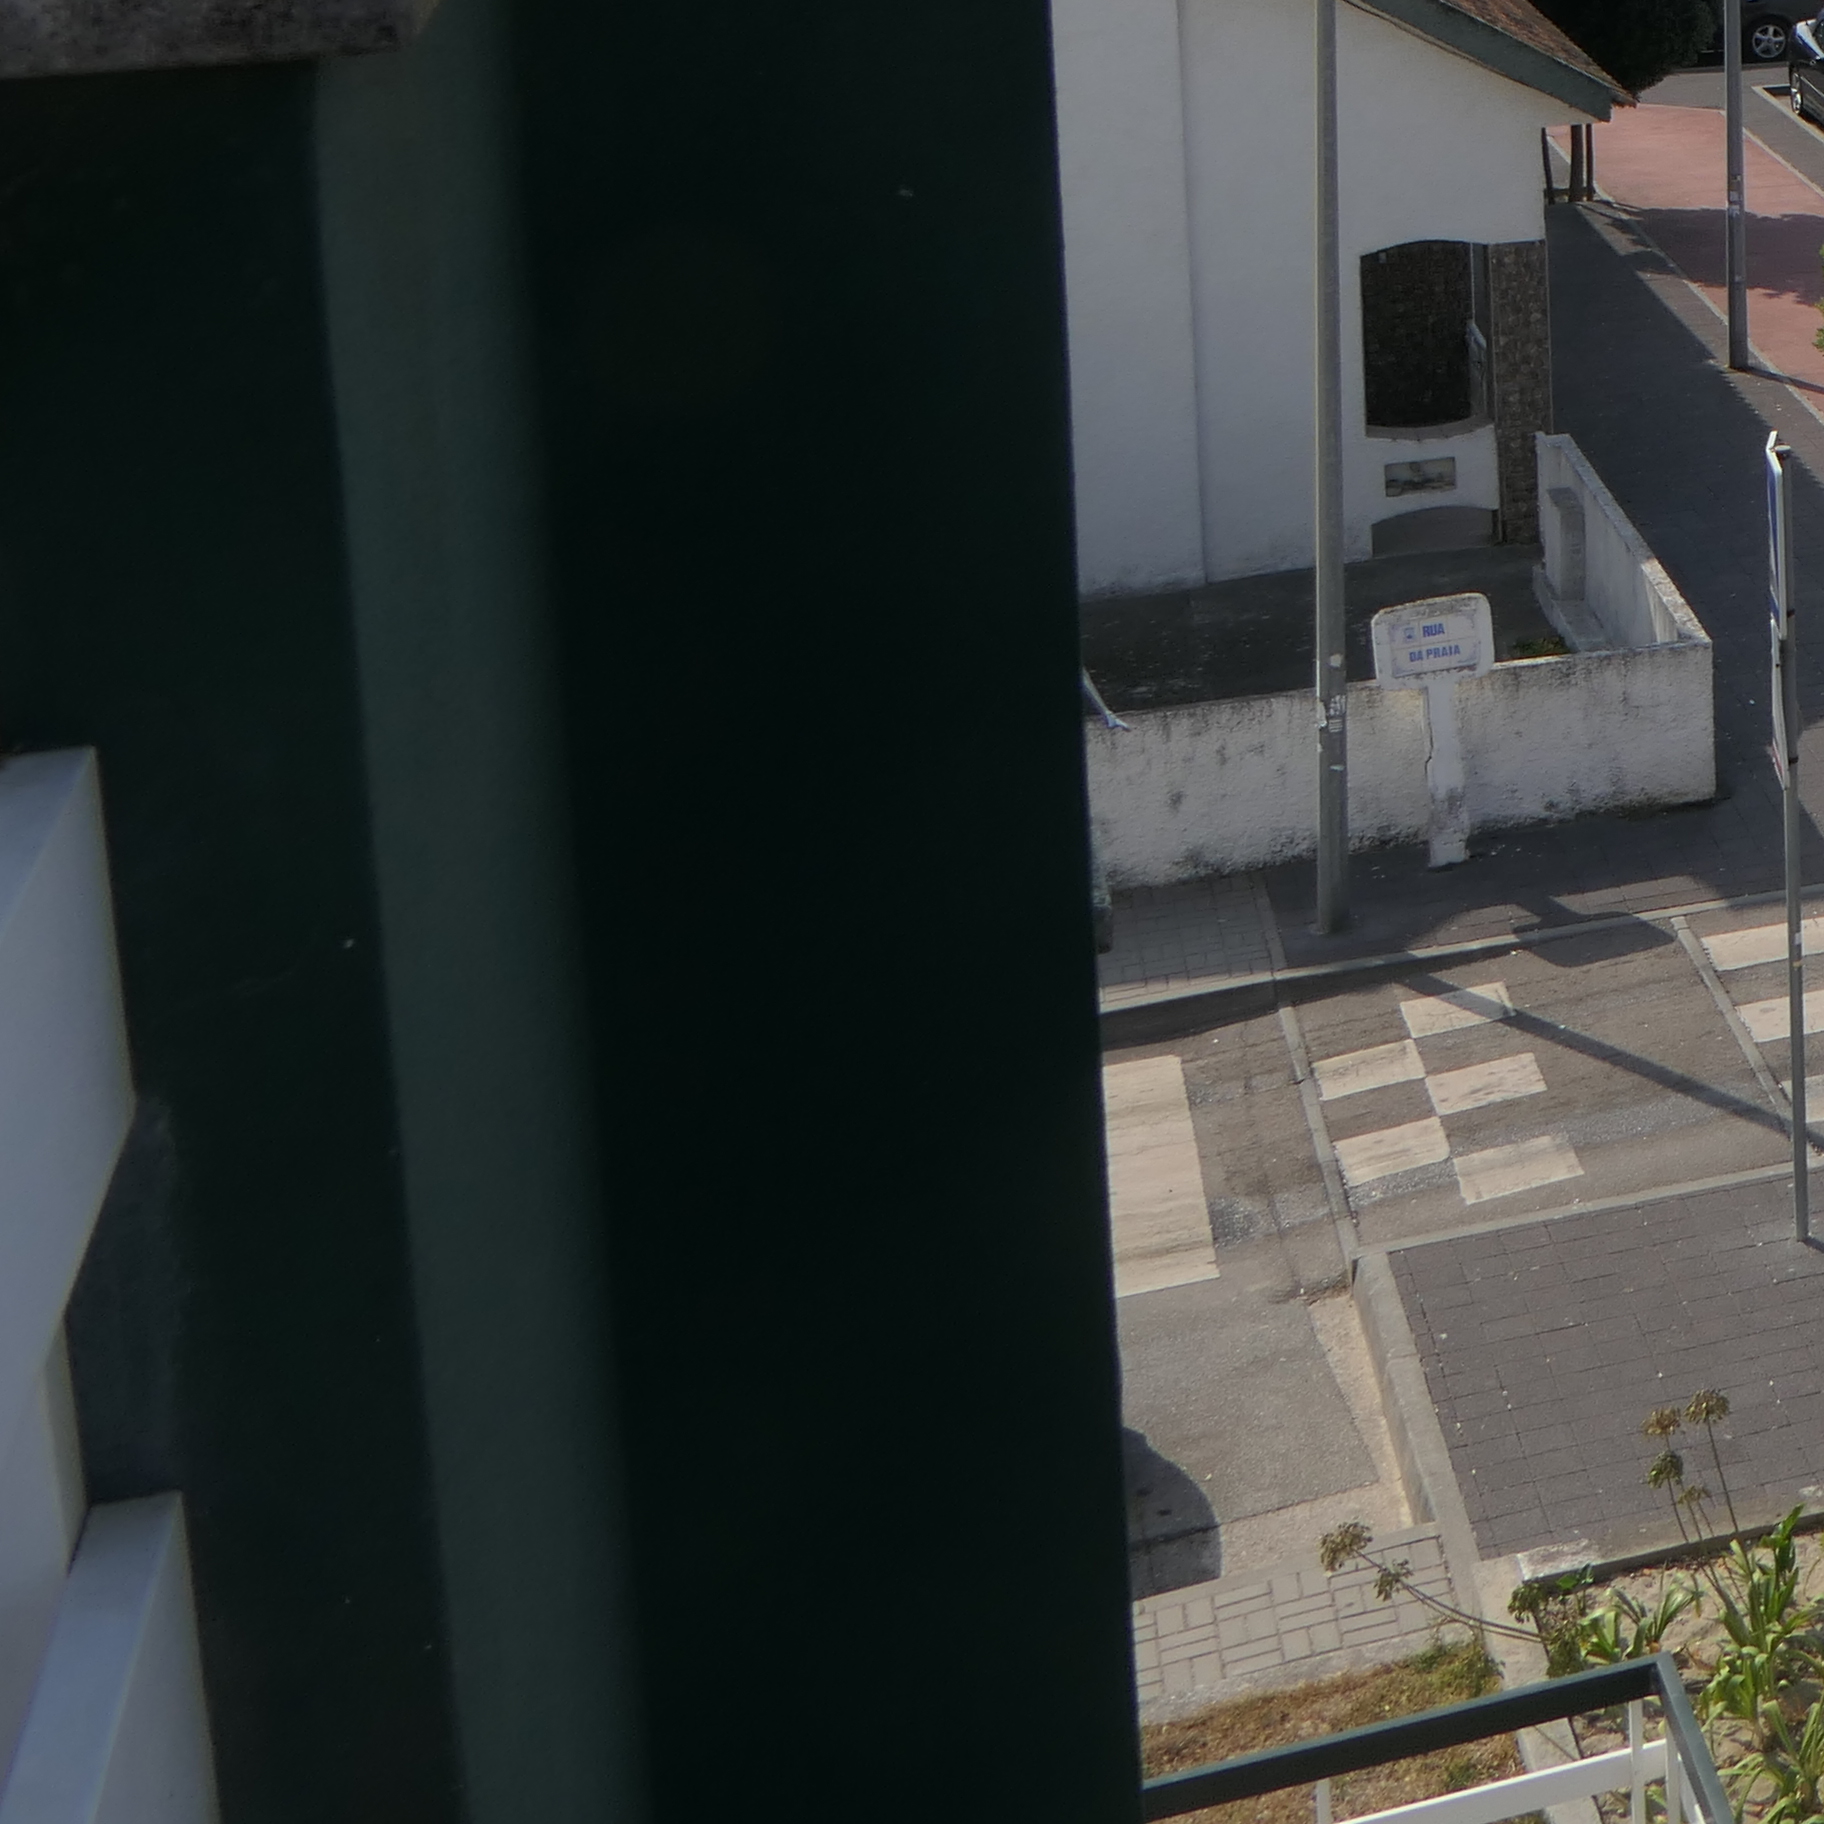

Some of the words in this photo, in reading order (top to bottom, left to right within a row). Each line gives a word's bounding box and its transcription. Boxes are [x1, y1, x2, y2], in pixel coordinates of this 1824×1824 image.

[1422, 622, 1446, 638] RUA
[1409, 650, 1424, 663] DA
[1426, 644, 1461, 659] PRAIA
